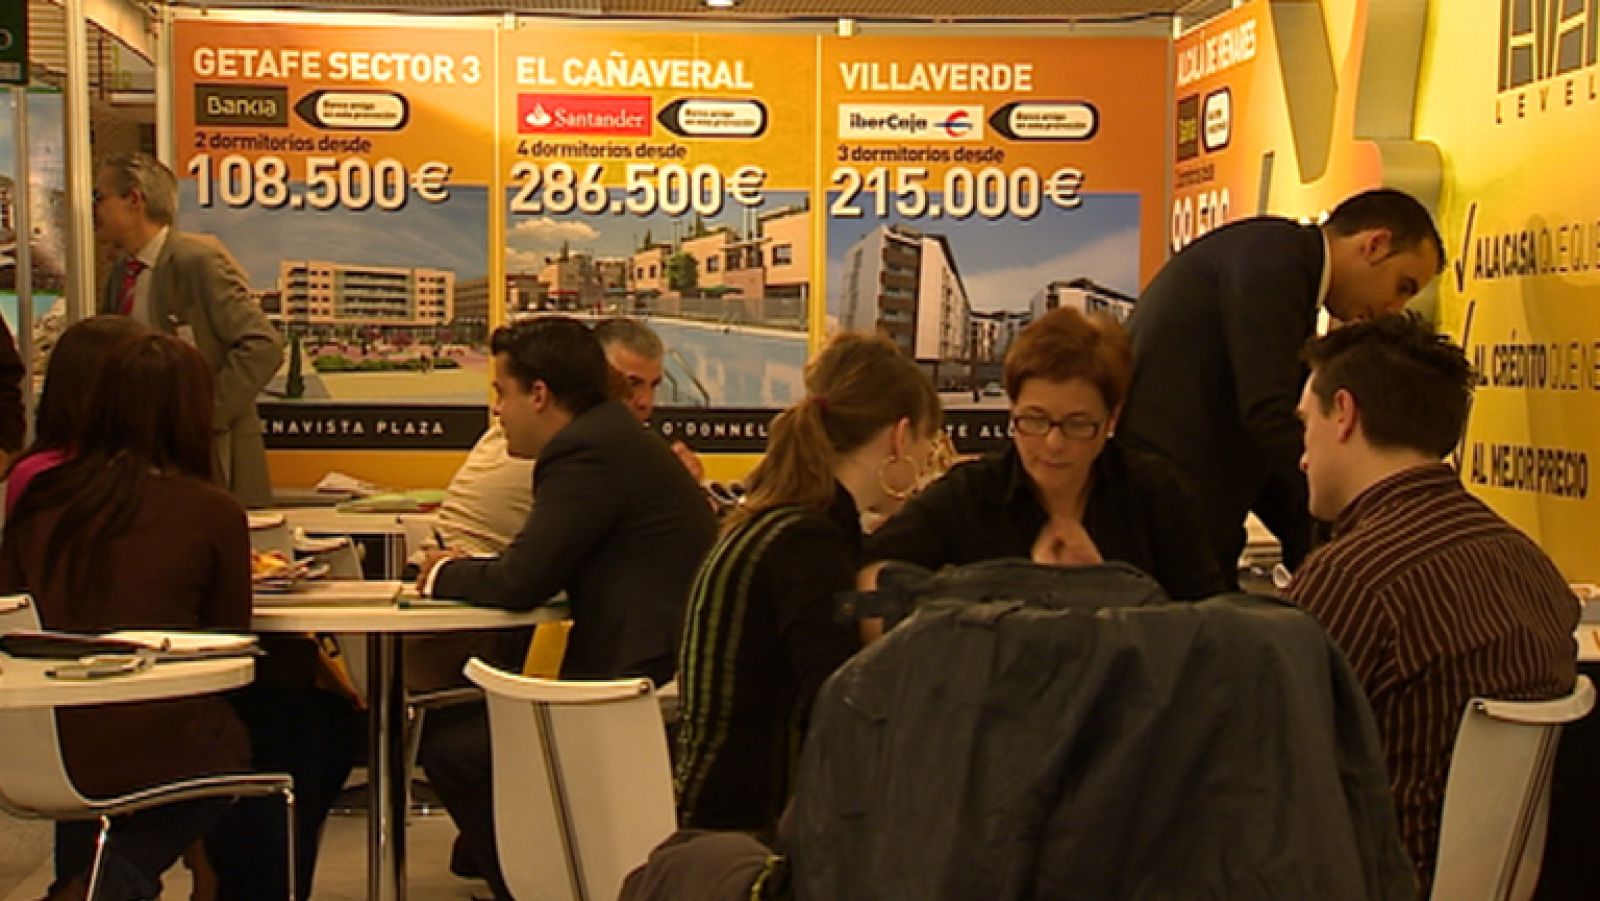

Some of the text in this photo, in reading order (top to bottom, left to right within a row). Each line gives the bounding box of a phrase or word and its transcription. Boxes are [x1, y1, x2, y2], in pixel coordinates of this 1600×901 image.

[193, 47, 480, 83] GETAFE SECTOR 3
[516, 51, 753, 89] EL CAÑAVERAL
[839, 62, 1034, 91] VILLAVERDE
[207, 96, 277, 118] Bankia
[1496, 72, 1597, 125] LEVEL
[553, 107, 645, 129] Santander
[849, 112, 927, 133] iberCaja
[195, 133, 371, 153] 2 dormitorios desde
[517, 141, 687, 159] 4 dormitorios desde
[838, 146, 1004, 164] 3 dormitorios desde
[188, 153, 452, 210] 108.500€
[510, 161, 768, 217] 286.500€
[830, 166, 1085, 220] 215.000€
[376, 420, 445, 435] PLAZA
[1471, 442, 1588, 499] AL MEJOR PRECIO
